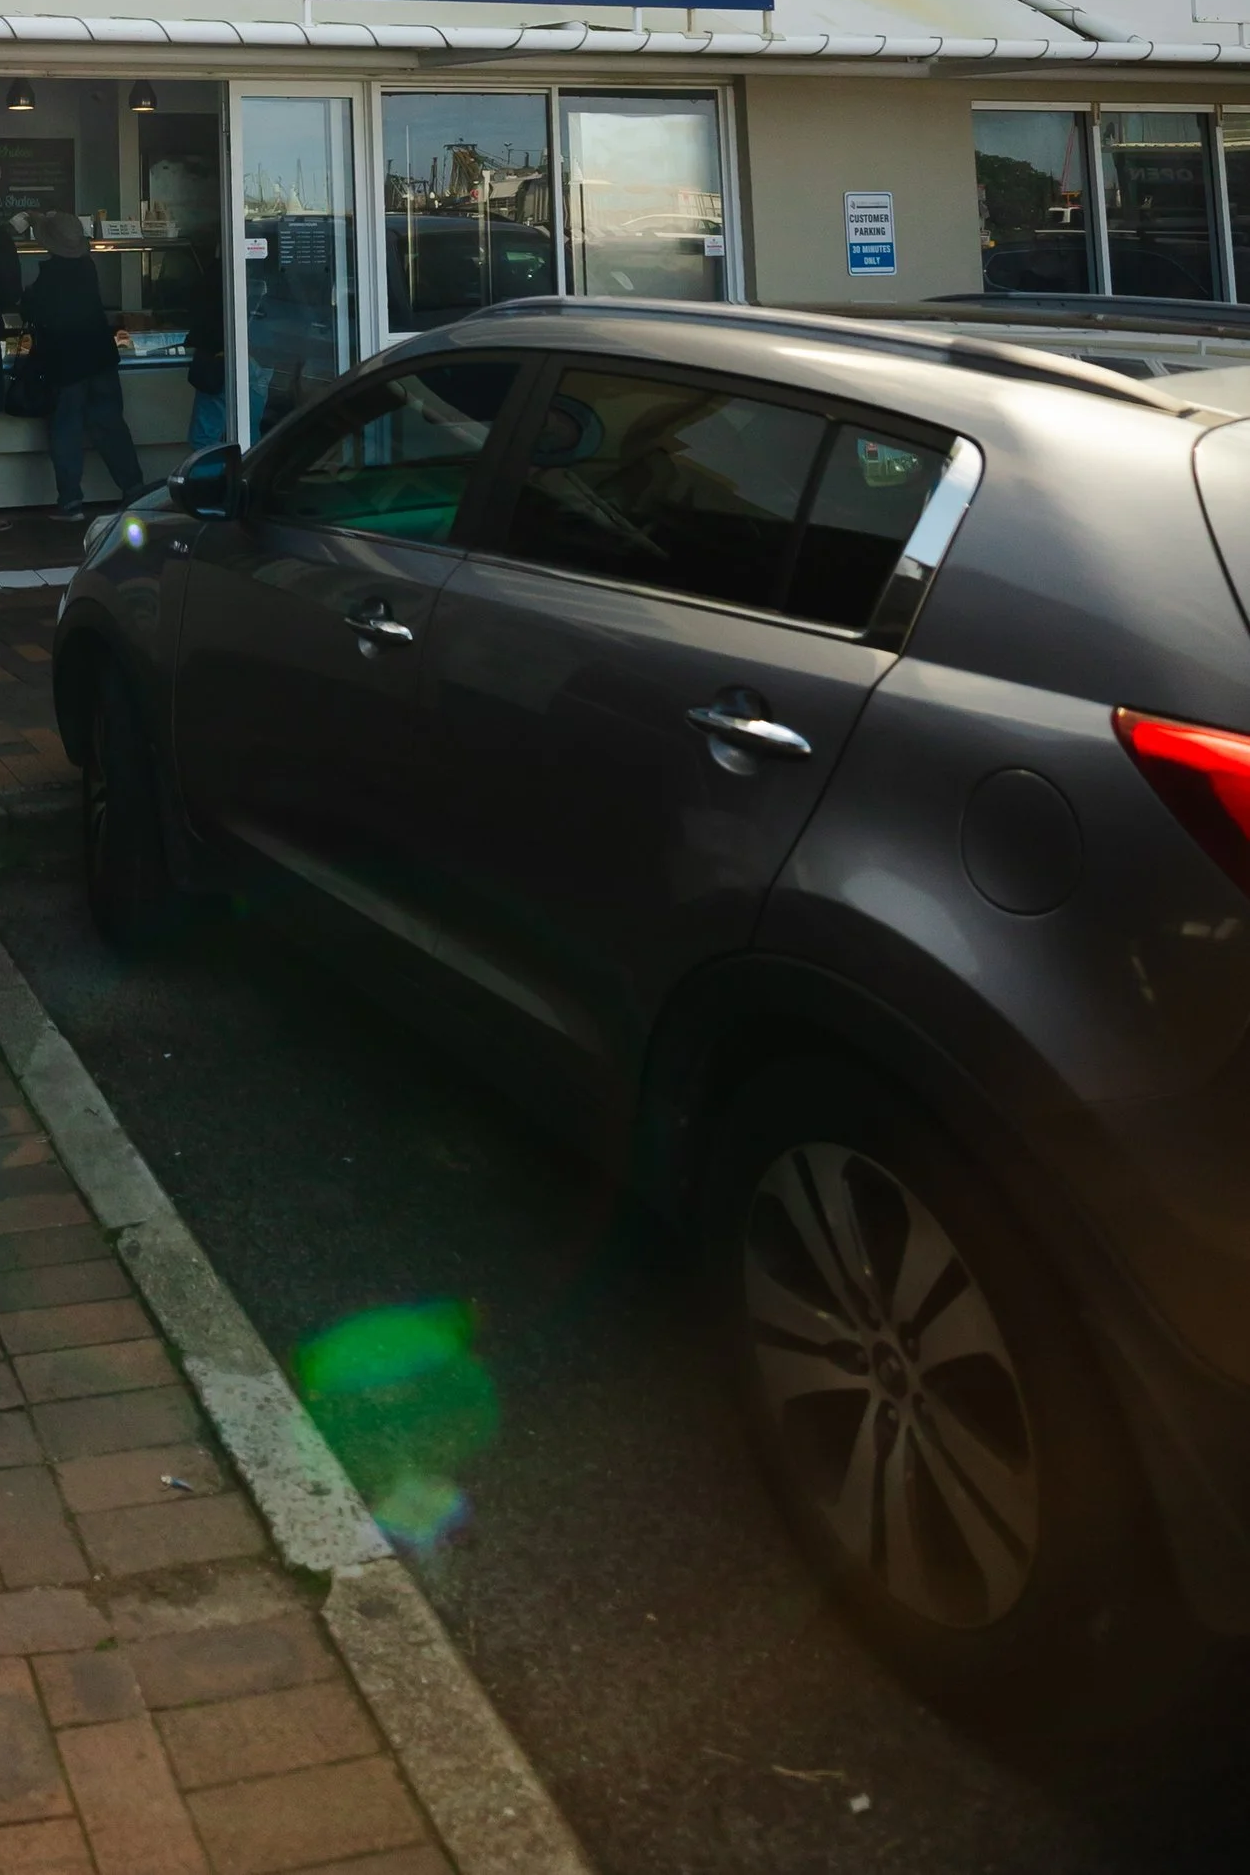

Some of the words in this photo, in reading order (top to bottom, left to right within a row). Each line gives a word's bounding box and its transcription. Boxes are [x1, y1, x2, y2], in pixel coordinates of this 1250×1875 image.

[849, 214, 889, 223] CUSTOMER
[854, 227, 886, 236] PARKING
[862, 245, 891, 254] MINUTES
[863, 256, 881, 265] ONLY
